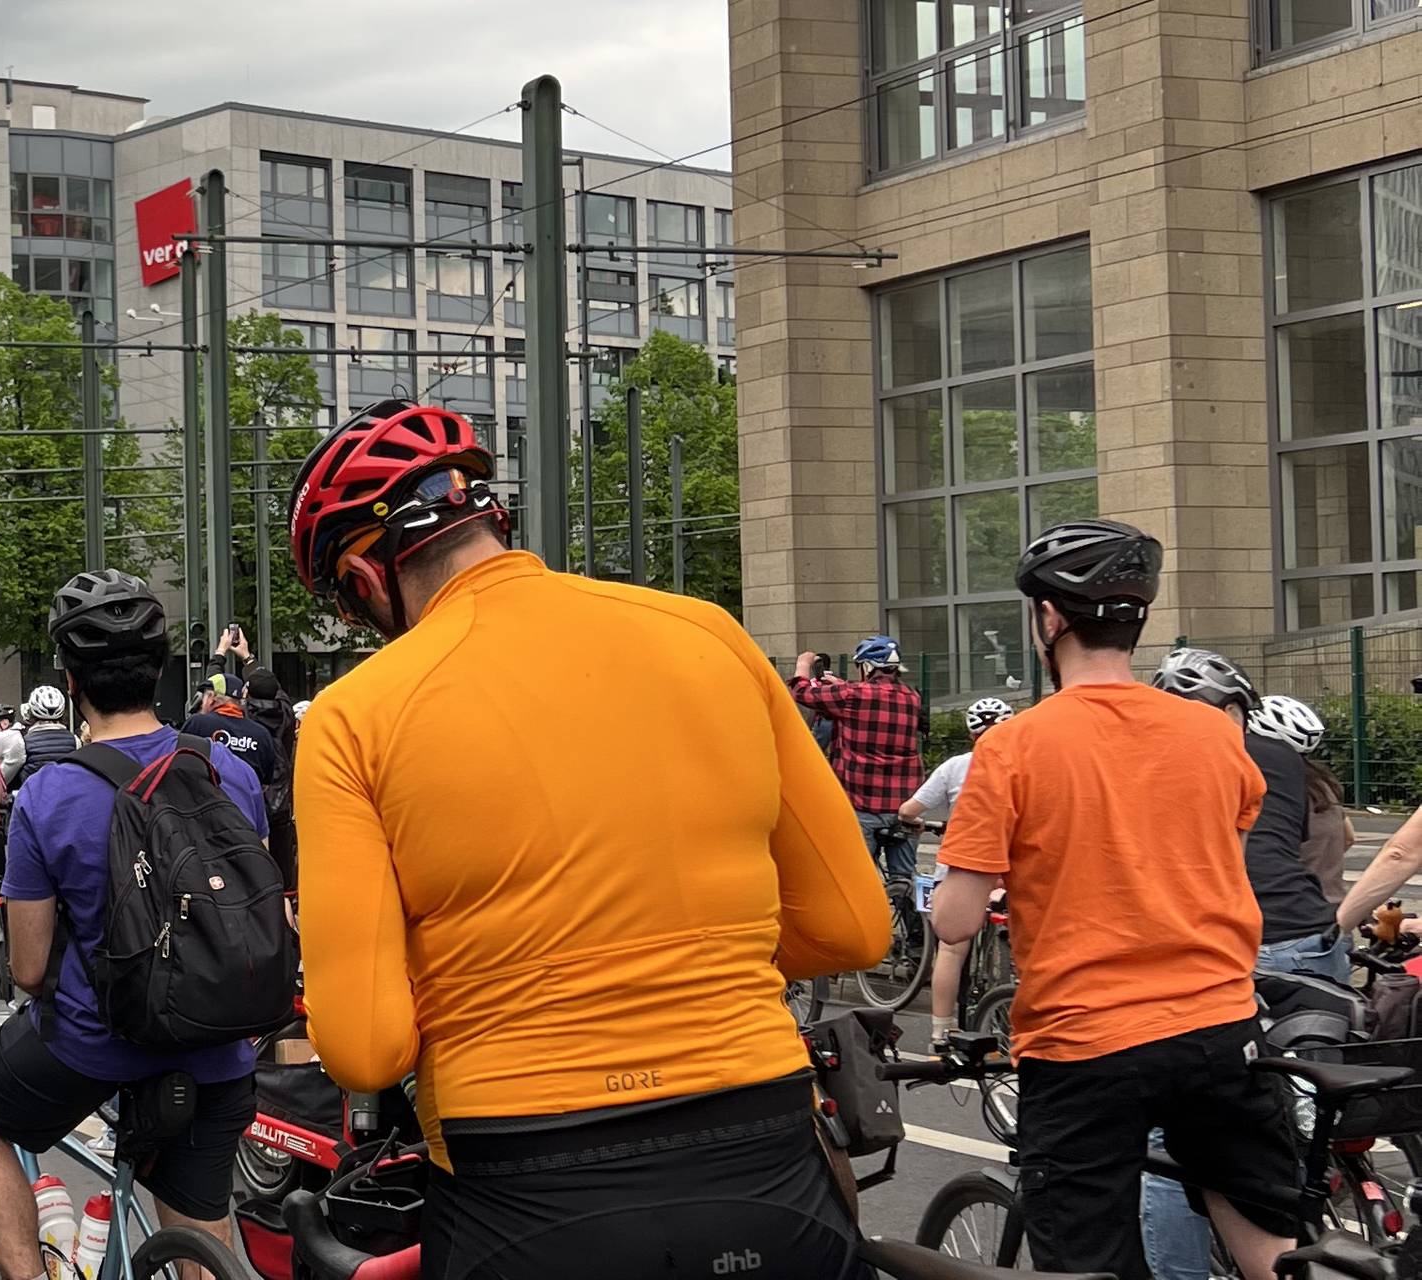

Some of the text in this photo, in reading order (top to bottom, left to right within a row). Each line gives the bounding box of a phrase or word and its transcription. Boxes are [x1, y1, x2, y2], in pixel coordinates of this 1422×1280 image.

[229, 735, 258, 751] adfc
[606, 1070, 663, 1092] GORE
[250, 1121, 291, 1148] BULLITT
[712, 1248, 761, 1274] dhb
